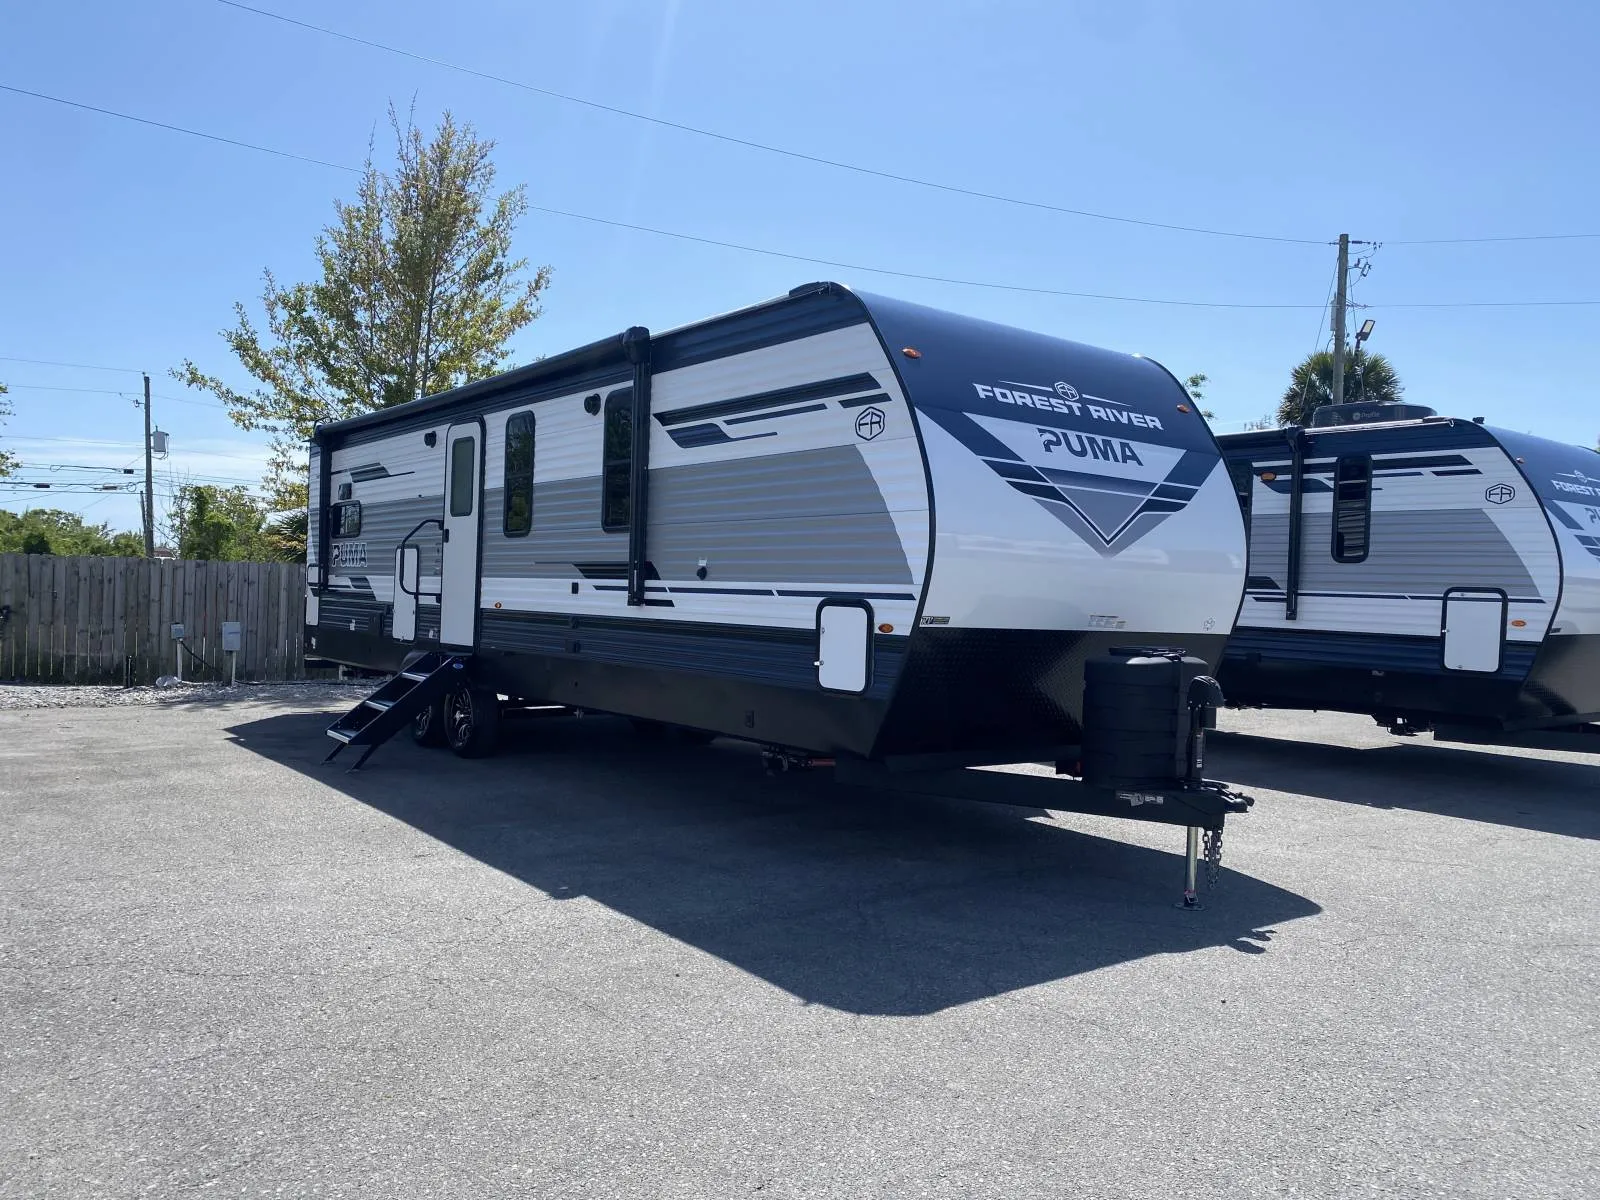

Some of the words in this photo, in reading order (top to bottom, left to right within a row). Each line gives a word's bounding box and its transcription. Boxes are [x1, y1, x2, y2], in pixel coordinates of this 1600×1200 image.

[972, 383, 1082, 416] FOREST
[1086, 404, 1164, 430] RIVER
[1037, 427, 1144, 466] PUMA
[1551, 480, 1596, 496] FOREST
[332, 542, 367, 567] PUMA
